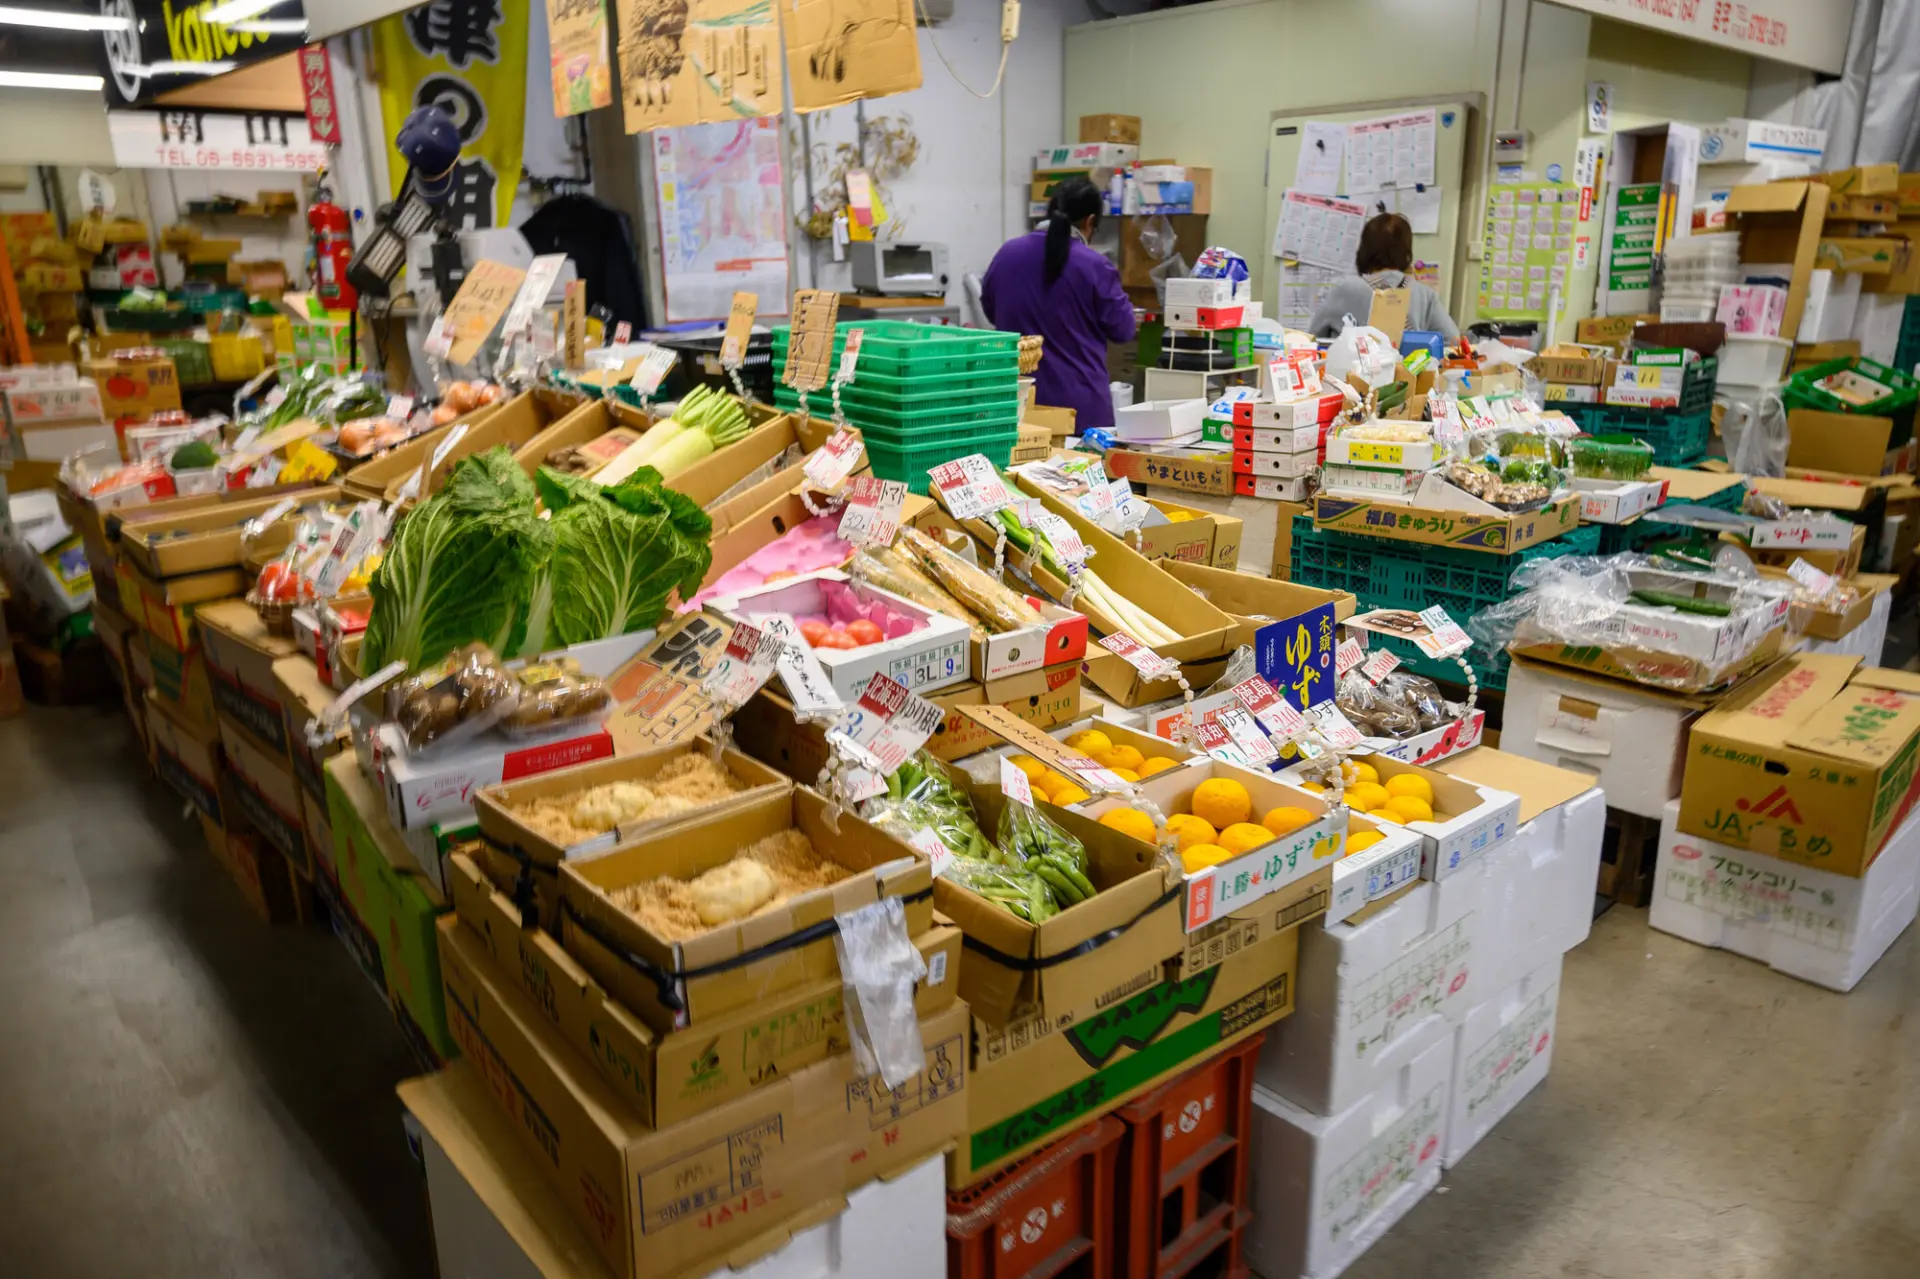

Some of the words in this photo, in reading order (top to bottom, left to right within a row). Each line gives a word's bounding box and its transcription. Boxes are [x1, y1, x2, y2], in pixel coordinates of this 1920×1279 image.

[1146, 463, 1208, 485] やまといも
[946, 657, 955, 677] 9
[1285, 623, 1321, 709] ゆず
[1335, 643, 1362, 674] ¥300
[916, 665, 937, 684] 3L
[867, 674, 910, 712] 北海道
[1235, 677, 1274, 707] 徳島
[1197, 723, 1226, 745] 高知
[1704, 808, 1833, 857] JAるめ
